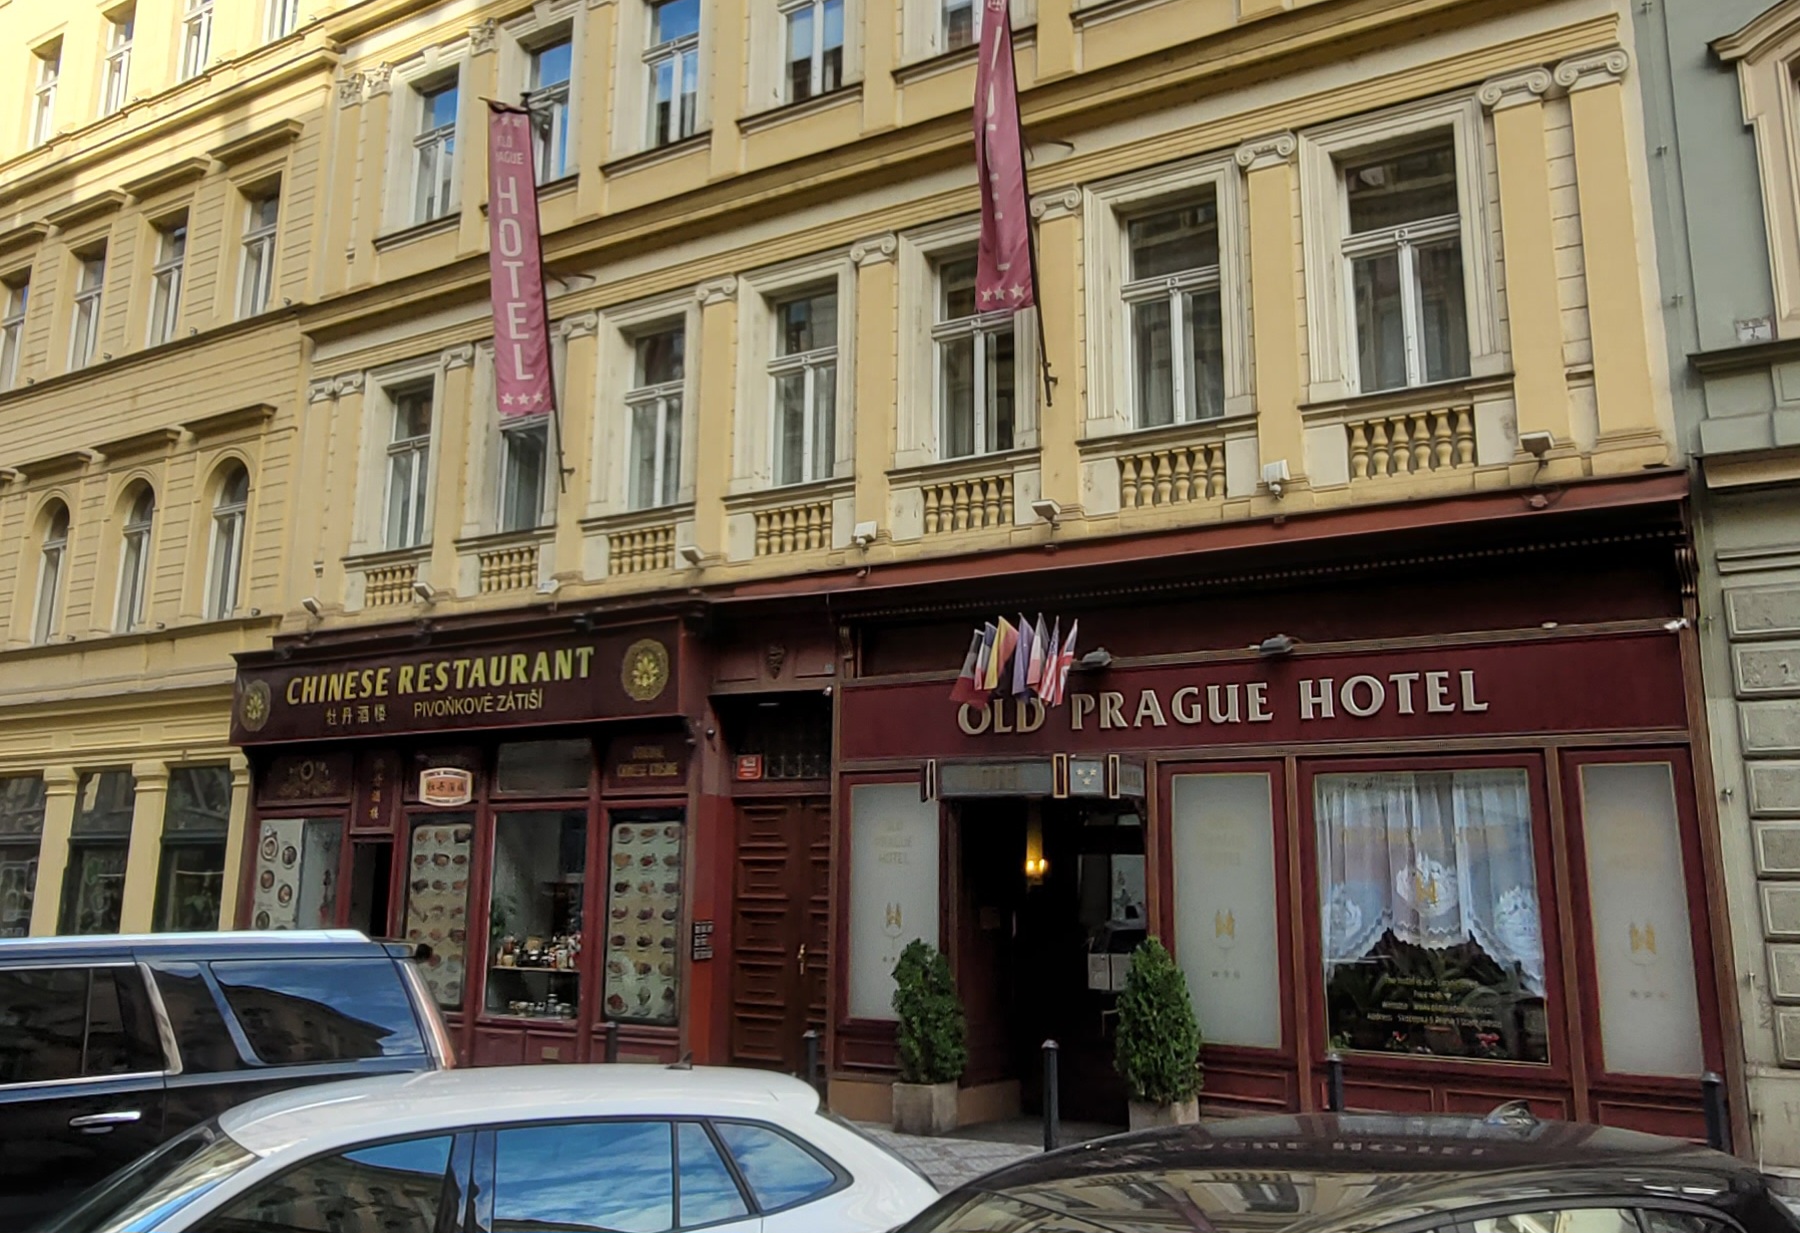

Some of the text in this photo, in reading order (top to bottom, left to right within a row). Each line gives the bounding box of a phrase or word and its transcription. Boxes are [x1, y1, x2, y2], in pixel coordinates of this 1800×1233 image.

[496, 176, 534, 381] HOTEL
[286, 646, 595, 705] CHINESE RESTAURANT
[413, 687, 543, 718] PIVOŇKOVÉ ZÁTIŠÍ
[957, 670, 1489, 735] OLD PRAGUE HOTEL
